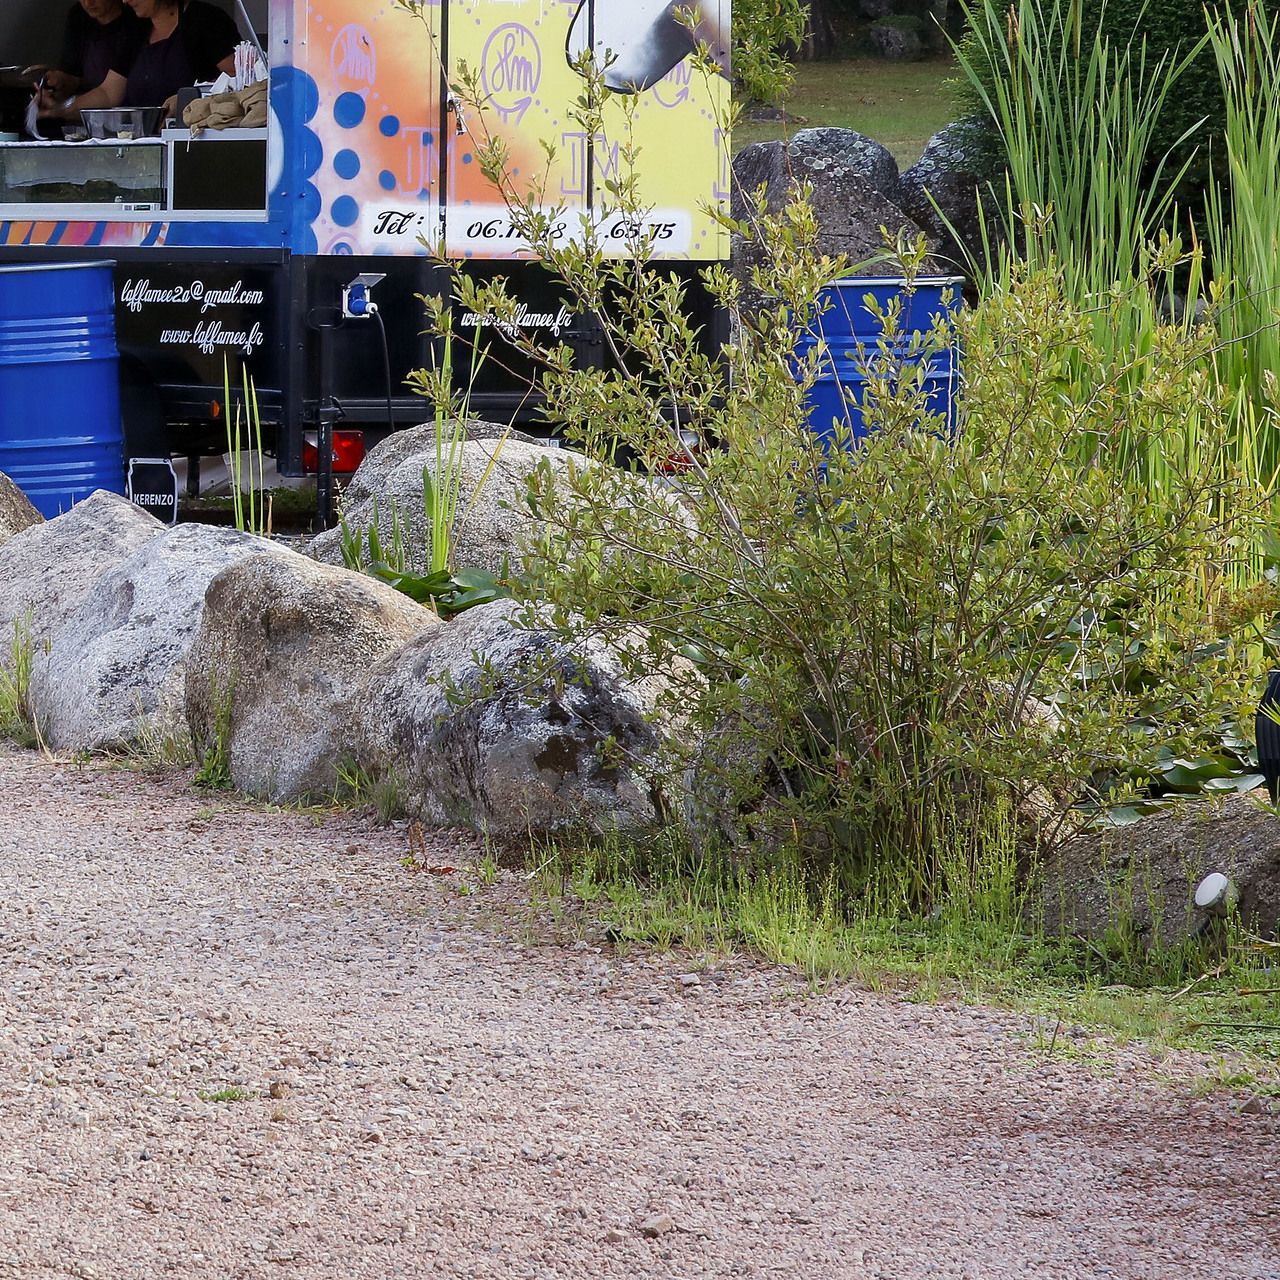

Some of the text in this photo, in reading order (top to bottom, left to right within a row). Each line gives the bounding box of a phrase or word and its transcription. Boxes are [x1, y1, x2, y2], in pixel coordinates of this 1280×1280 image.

[120, 278, 264, 314] laffamee2a@gmail.com
[159, 320, 264, 355] www.laffamee.fr
[133, 493, 174, 506] KERENZO
